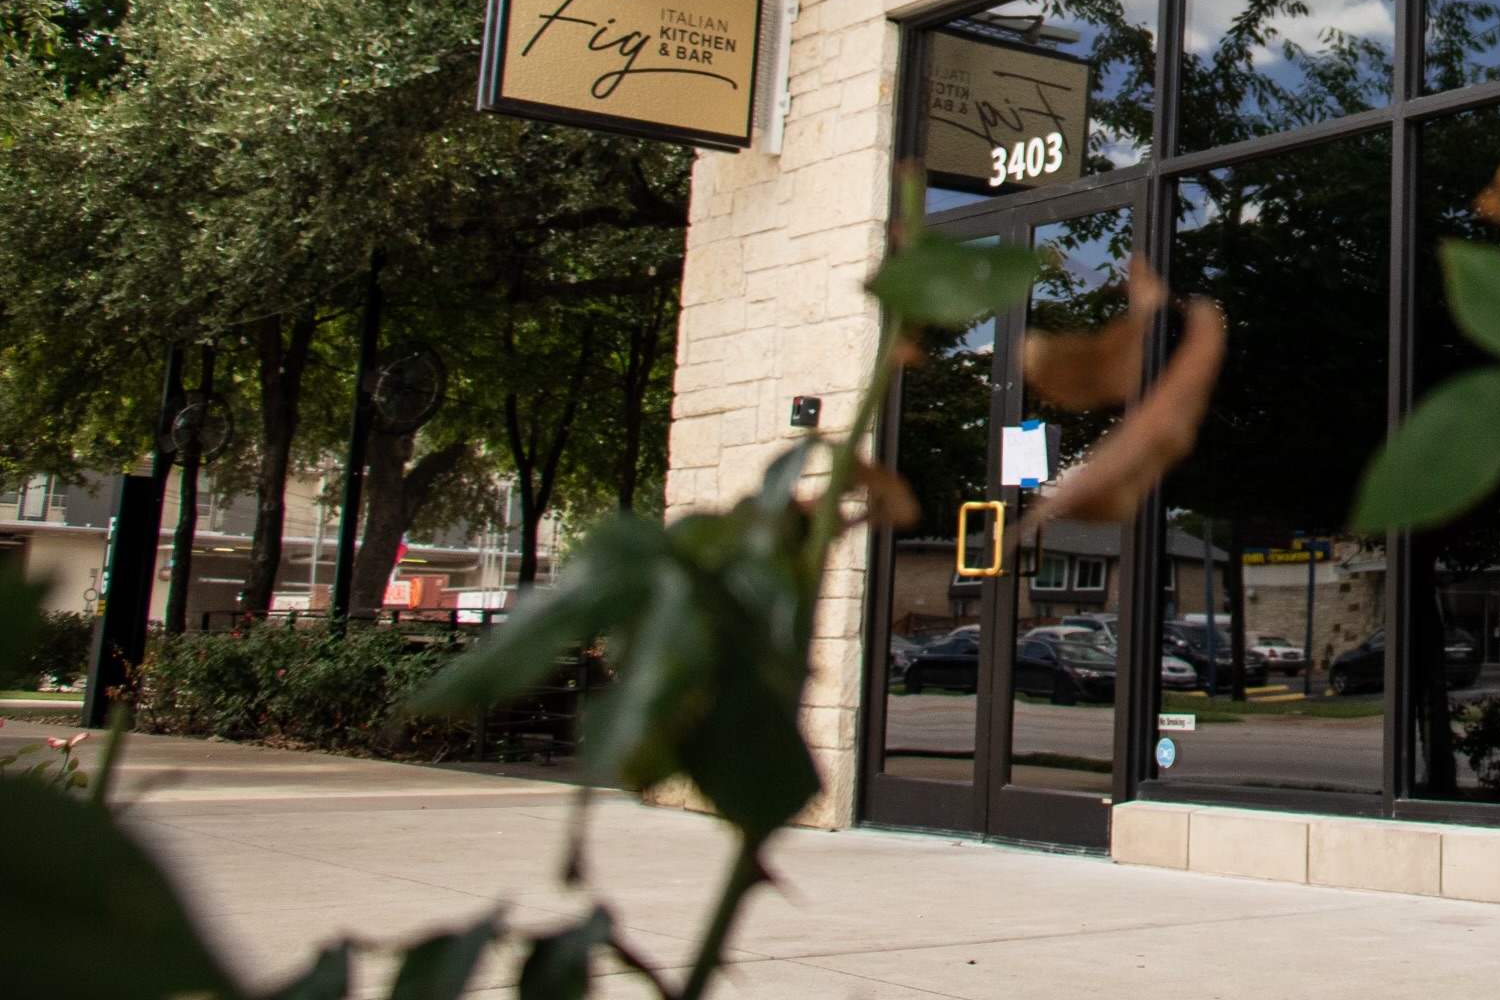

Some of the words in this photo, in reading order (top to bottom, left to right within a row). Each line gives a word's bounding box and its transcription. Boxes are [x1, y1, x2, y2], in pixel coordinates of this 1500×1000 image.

[660, 8, 730, 33] ITALIAN
[660, 25, 737, 53] KITCHEN
[659, 42, 670, 57] &
[676, 45, 713, 65] BAR
[988, 132, 1064, 187] 3403
